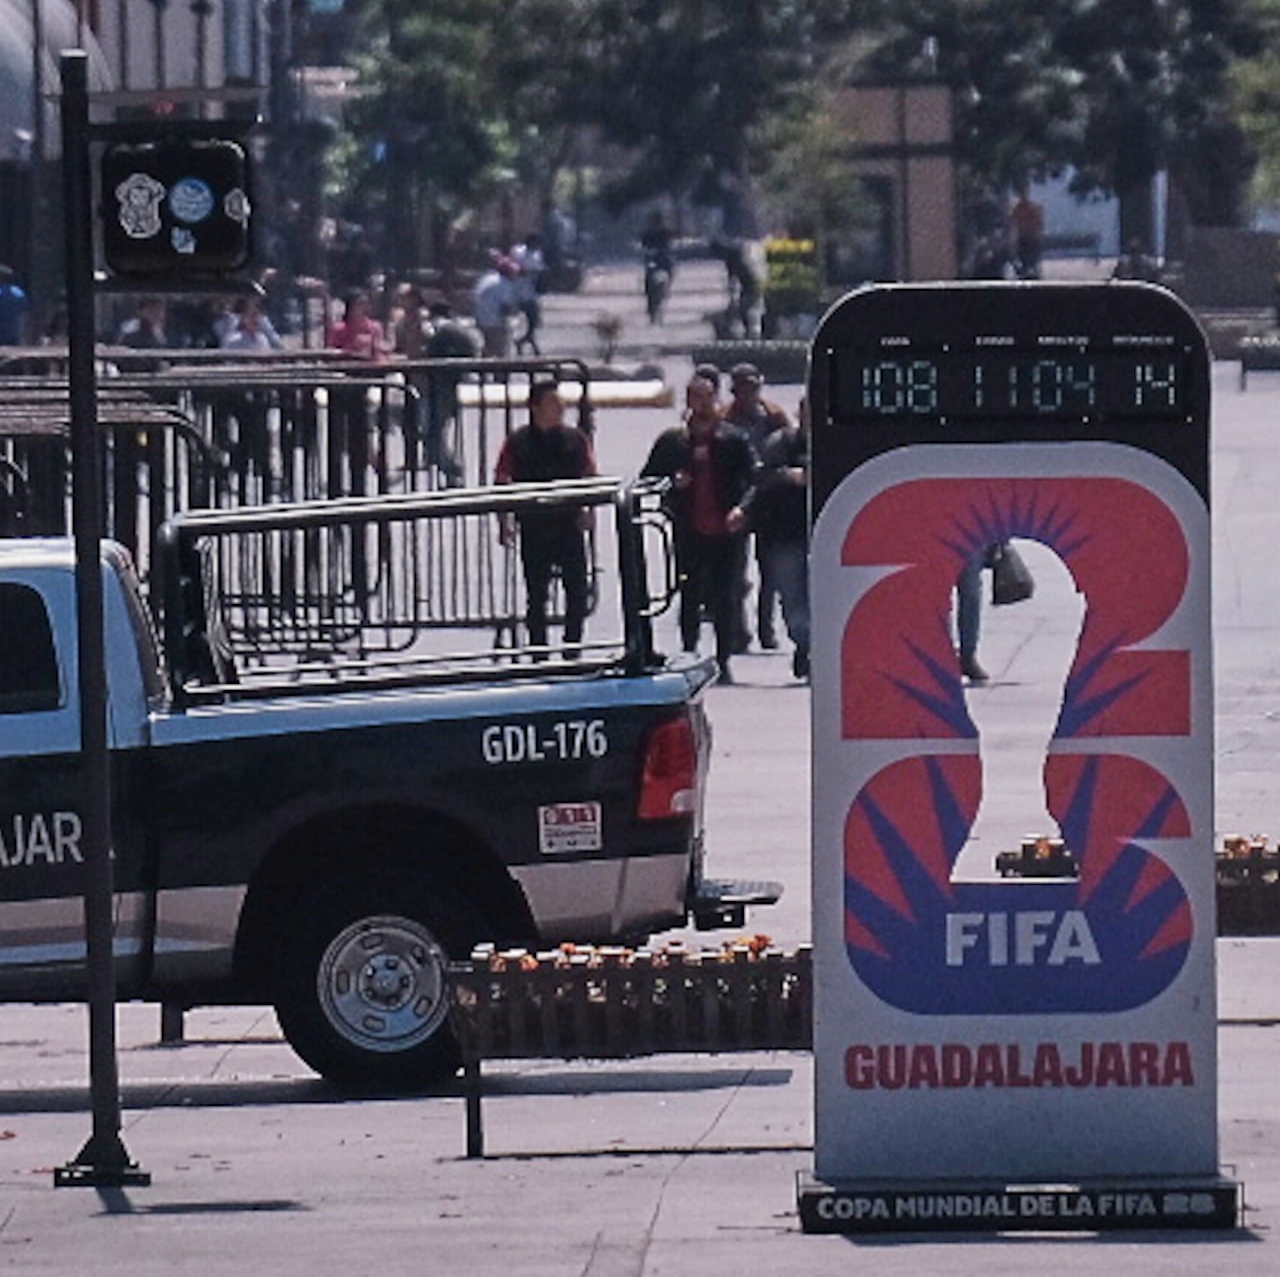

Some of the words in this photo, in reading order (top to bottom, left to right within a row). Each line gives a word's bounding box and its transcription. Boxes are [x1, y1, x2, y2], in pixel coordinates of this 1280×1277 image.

[862, 359, 937, 414] 108
[1032, 360, 1096, 411] 04
[1135, 364, 1176, 406] 14
[481, 719, 608, 764] GDL-176
[945, 910, 1102, 967] FIFA
[844, 1041, 1195, 1090] GUADALAJARA
[817, 1196, 890, 1220] COPA
[895, 1195, 1016, 1218] MUNDIAL
[1020, 1195, 1056, 1217] DE
[1059, 1194, 1095, 1216] LA
[1098, 1194, 1157, 1216] FIFA
